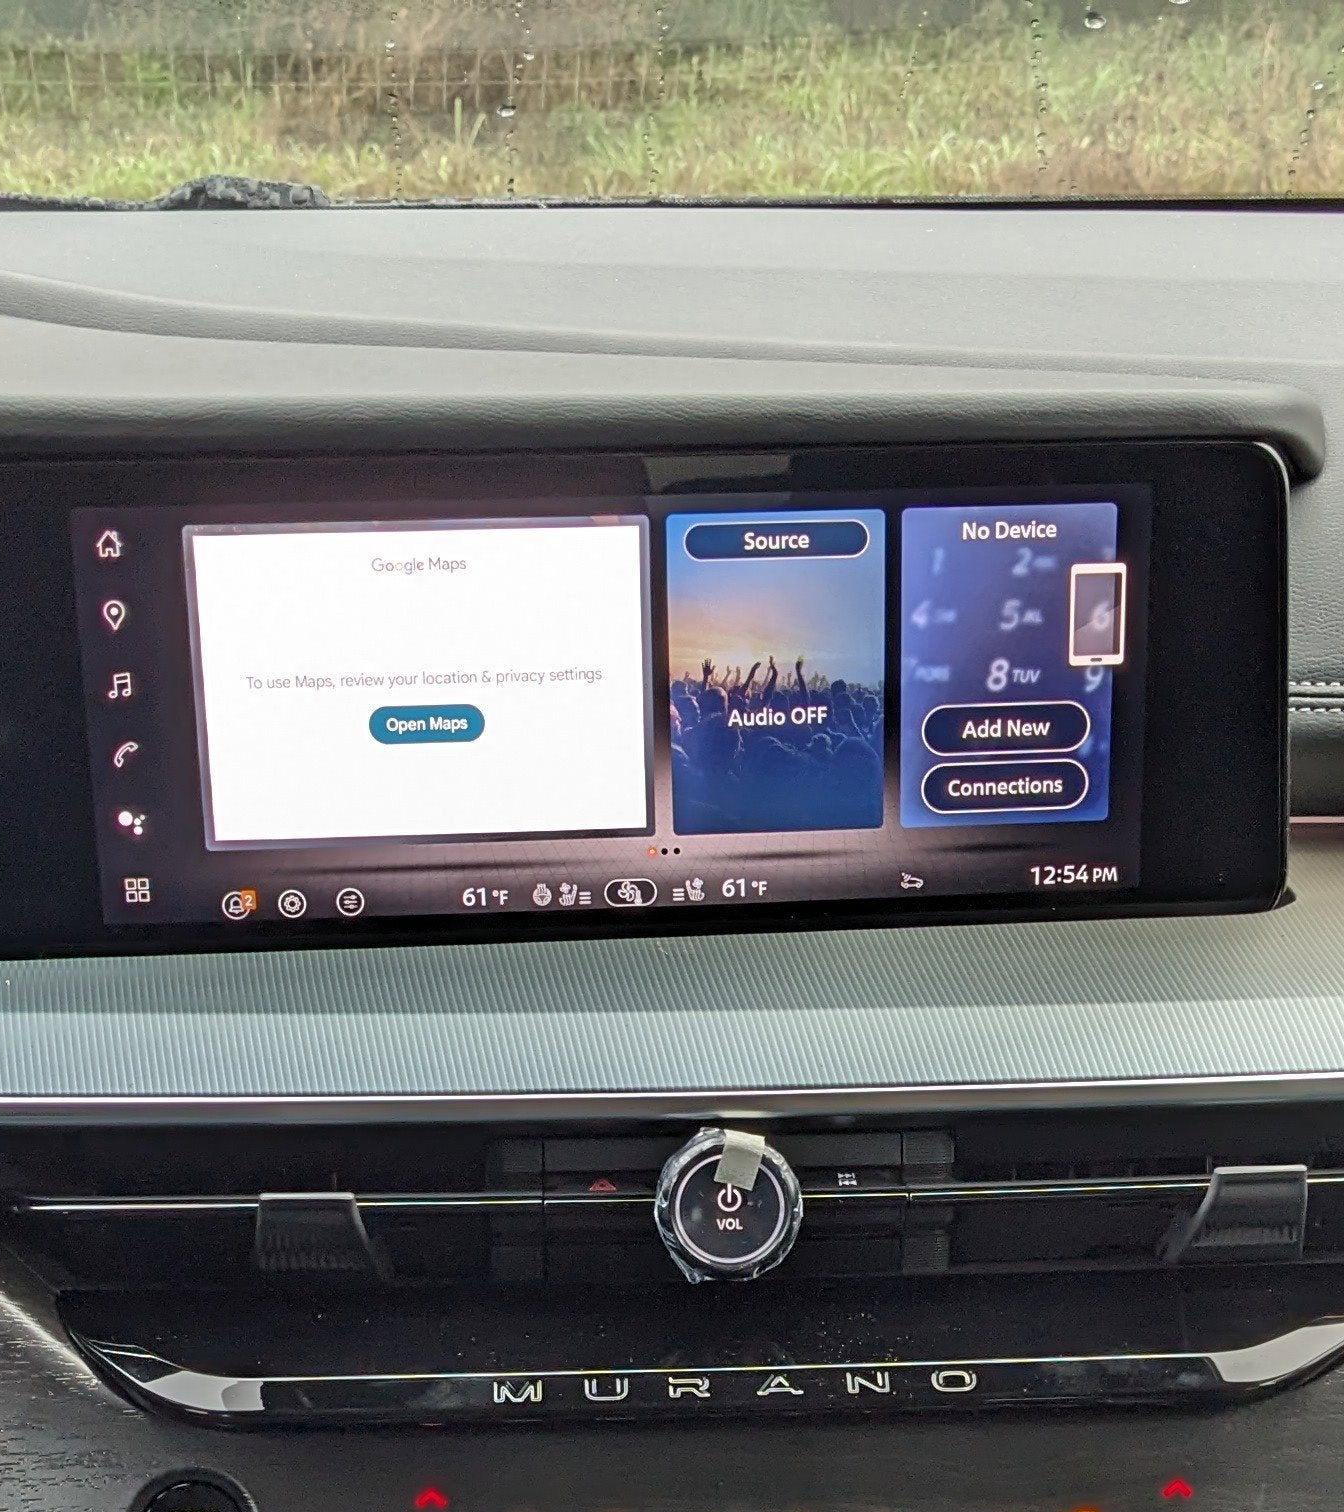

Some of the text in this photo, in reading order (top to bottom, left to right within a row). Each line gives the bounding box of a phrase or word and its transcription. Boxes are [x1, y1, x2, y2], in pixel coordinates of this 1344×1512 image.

[962, 520, 1057, 540] No Device
[743, 531, 810, 551] Source
[371, 557, 467, 576] Google Maps
[246, 667, 603, 691] To use Maps, review your location & privacy settings
[986, 656, 1010, 692] 8
[728, 705, 827, 726] Audio OFF
[386, 717, 468, 735] Open Maps
[962, 718, 1050, 738] Add New
[947, 775, 1063, 797] Connections
[1030, 864, 1118, 886] 12:54 PM
[462, 887, 487, 907] 61
[722, 878, 746, 897] 61
[716, 1218, 744, 1231] VOL
[492, 1370, 978, 1402] MURANO
